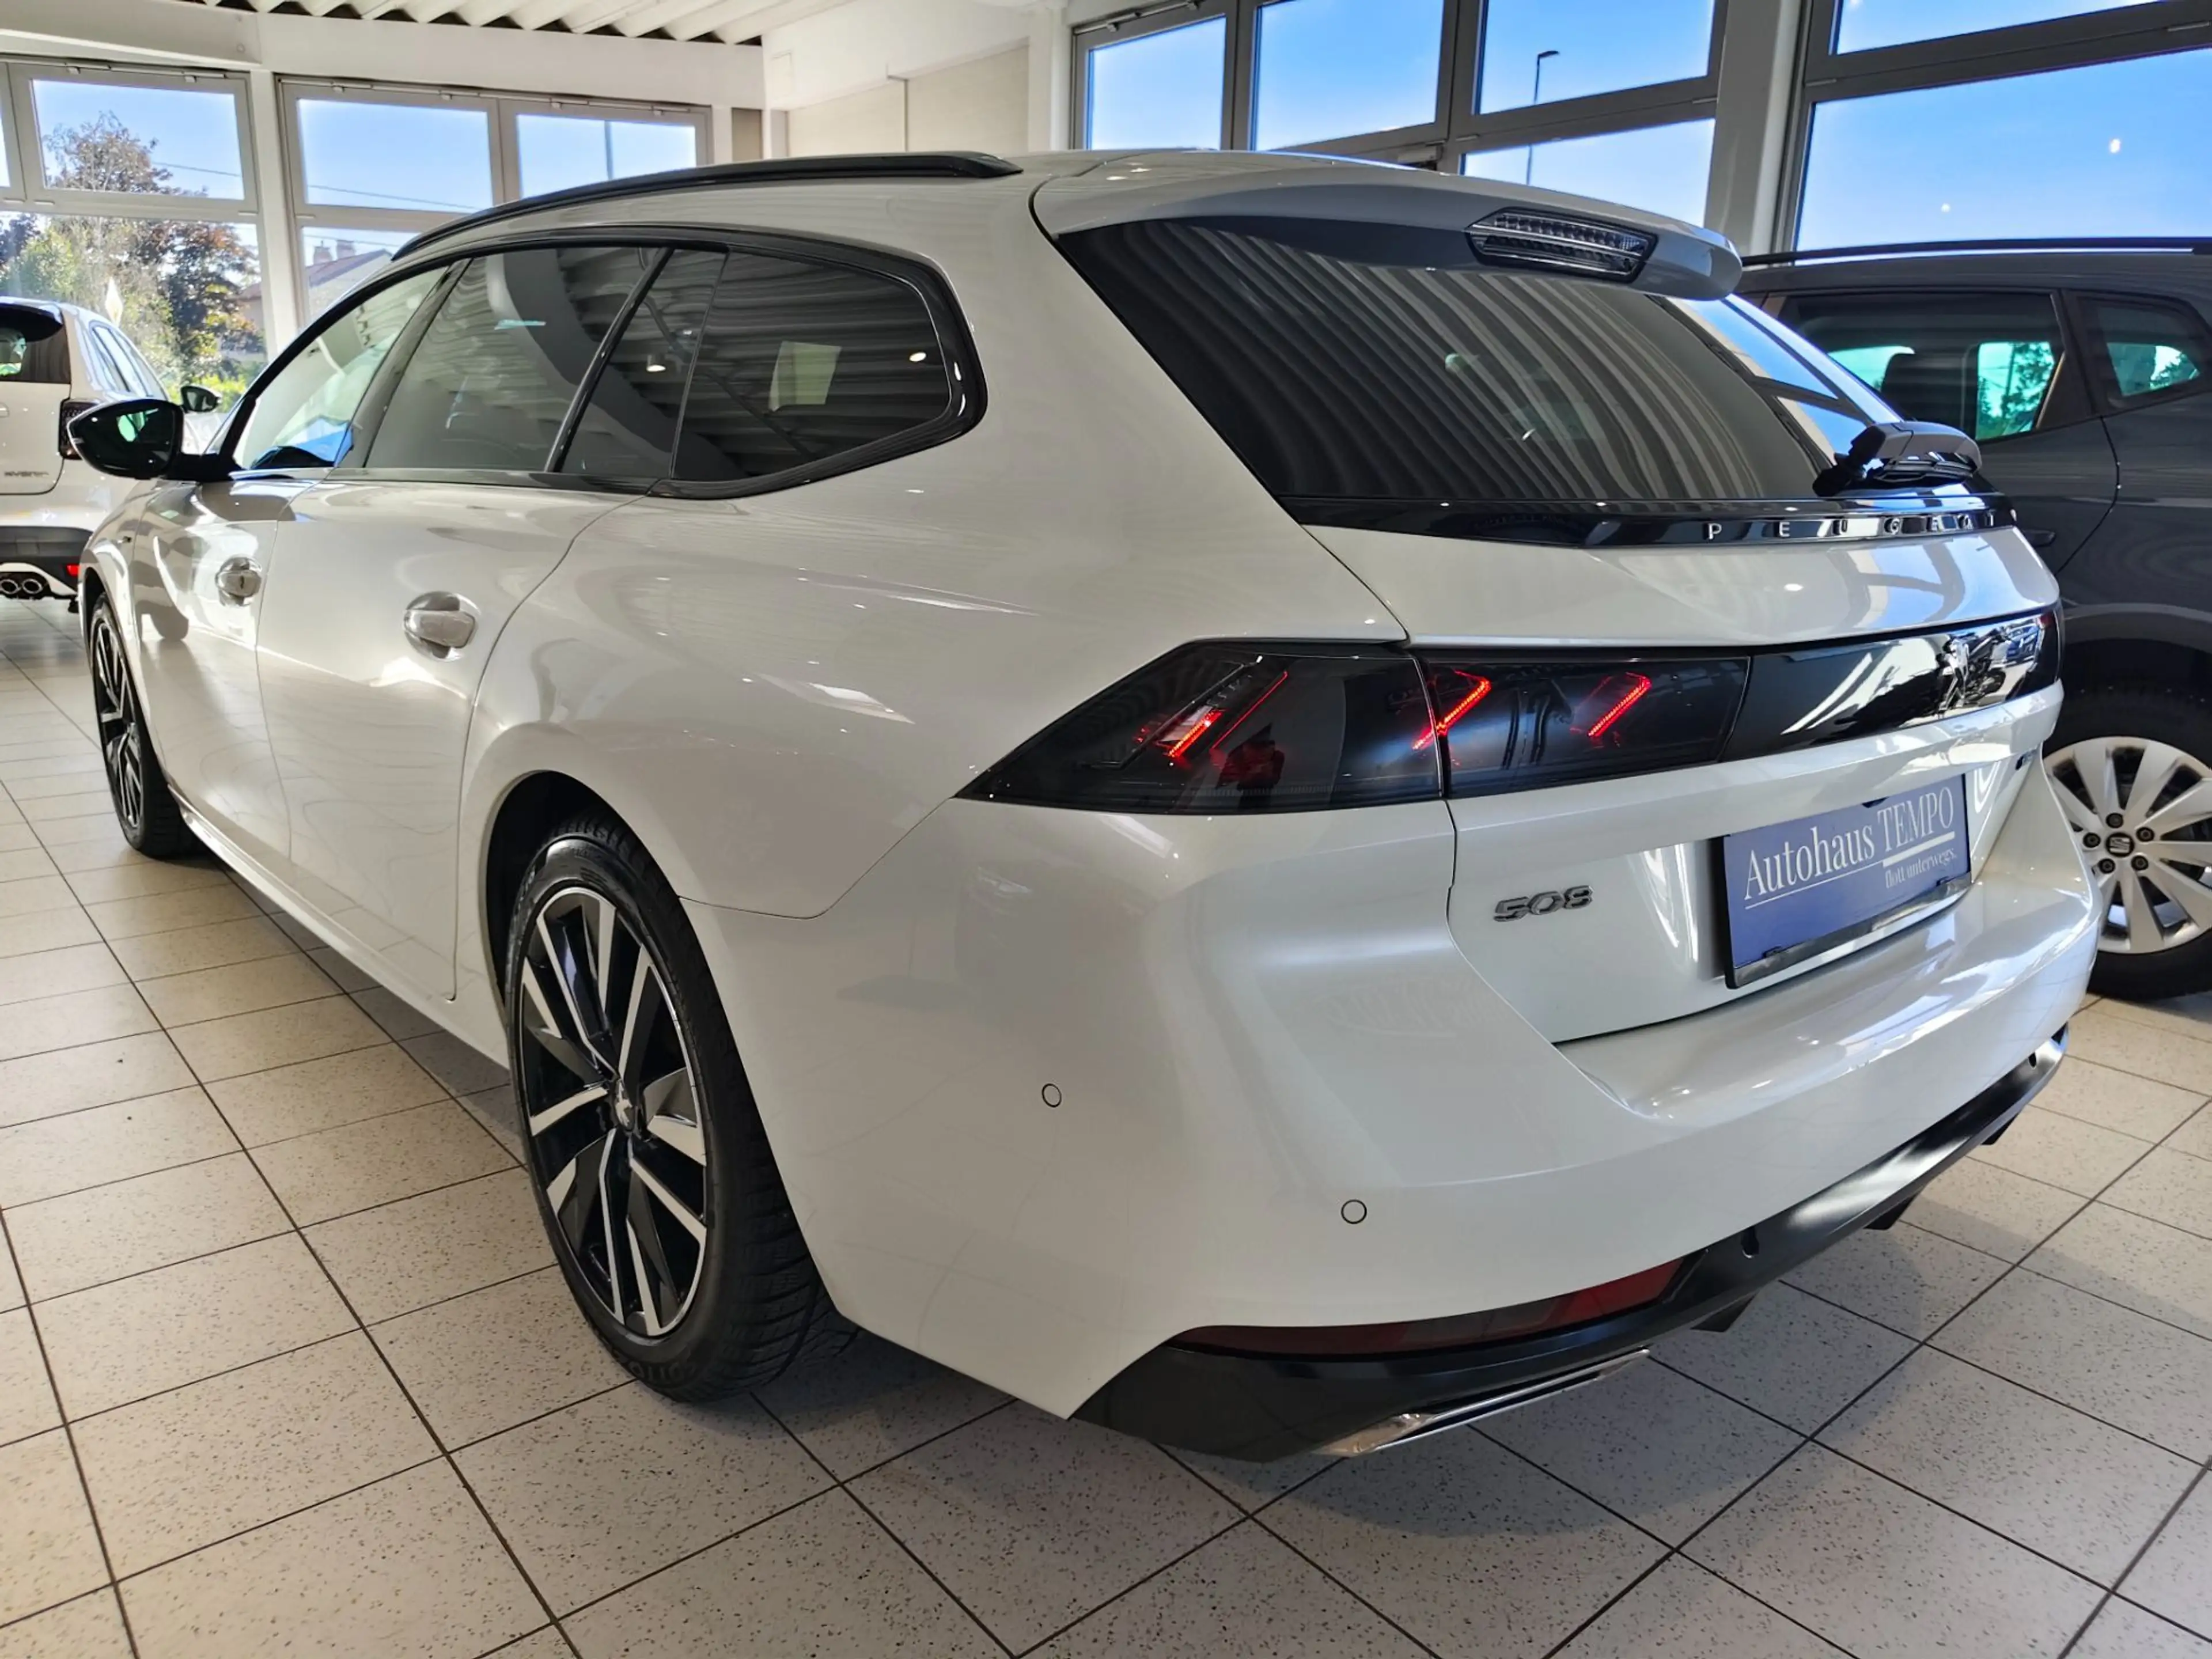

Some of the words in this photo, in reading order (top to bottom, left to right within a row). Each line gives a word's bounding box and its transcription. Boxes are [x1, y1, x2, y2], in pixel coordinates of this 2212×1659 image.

[1744, 827, 1875, 900] Autohaus
[1877, 787, 1953, 852] TEMPO
[1493, 885, 1593, 922] 508
